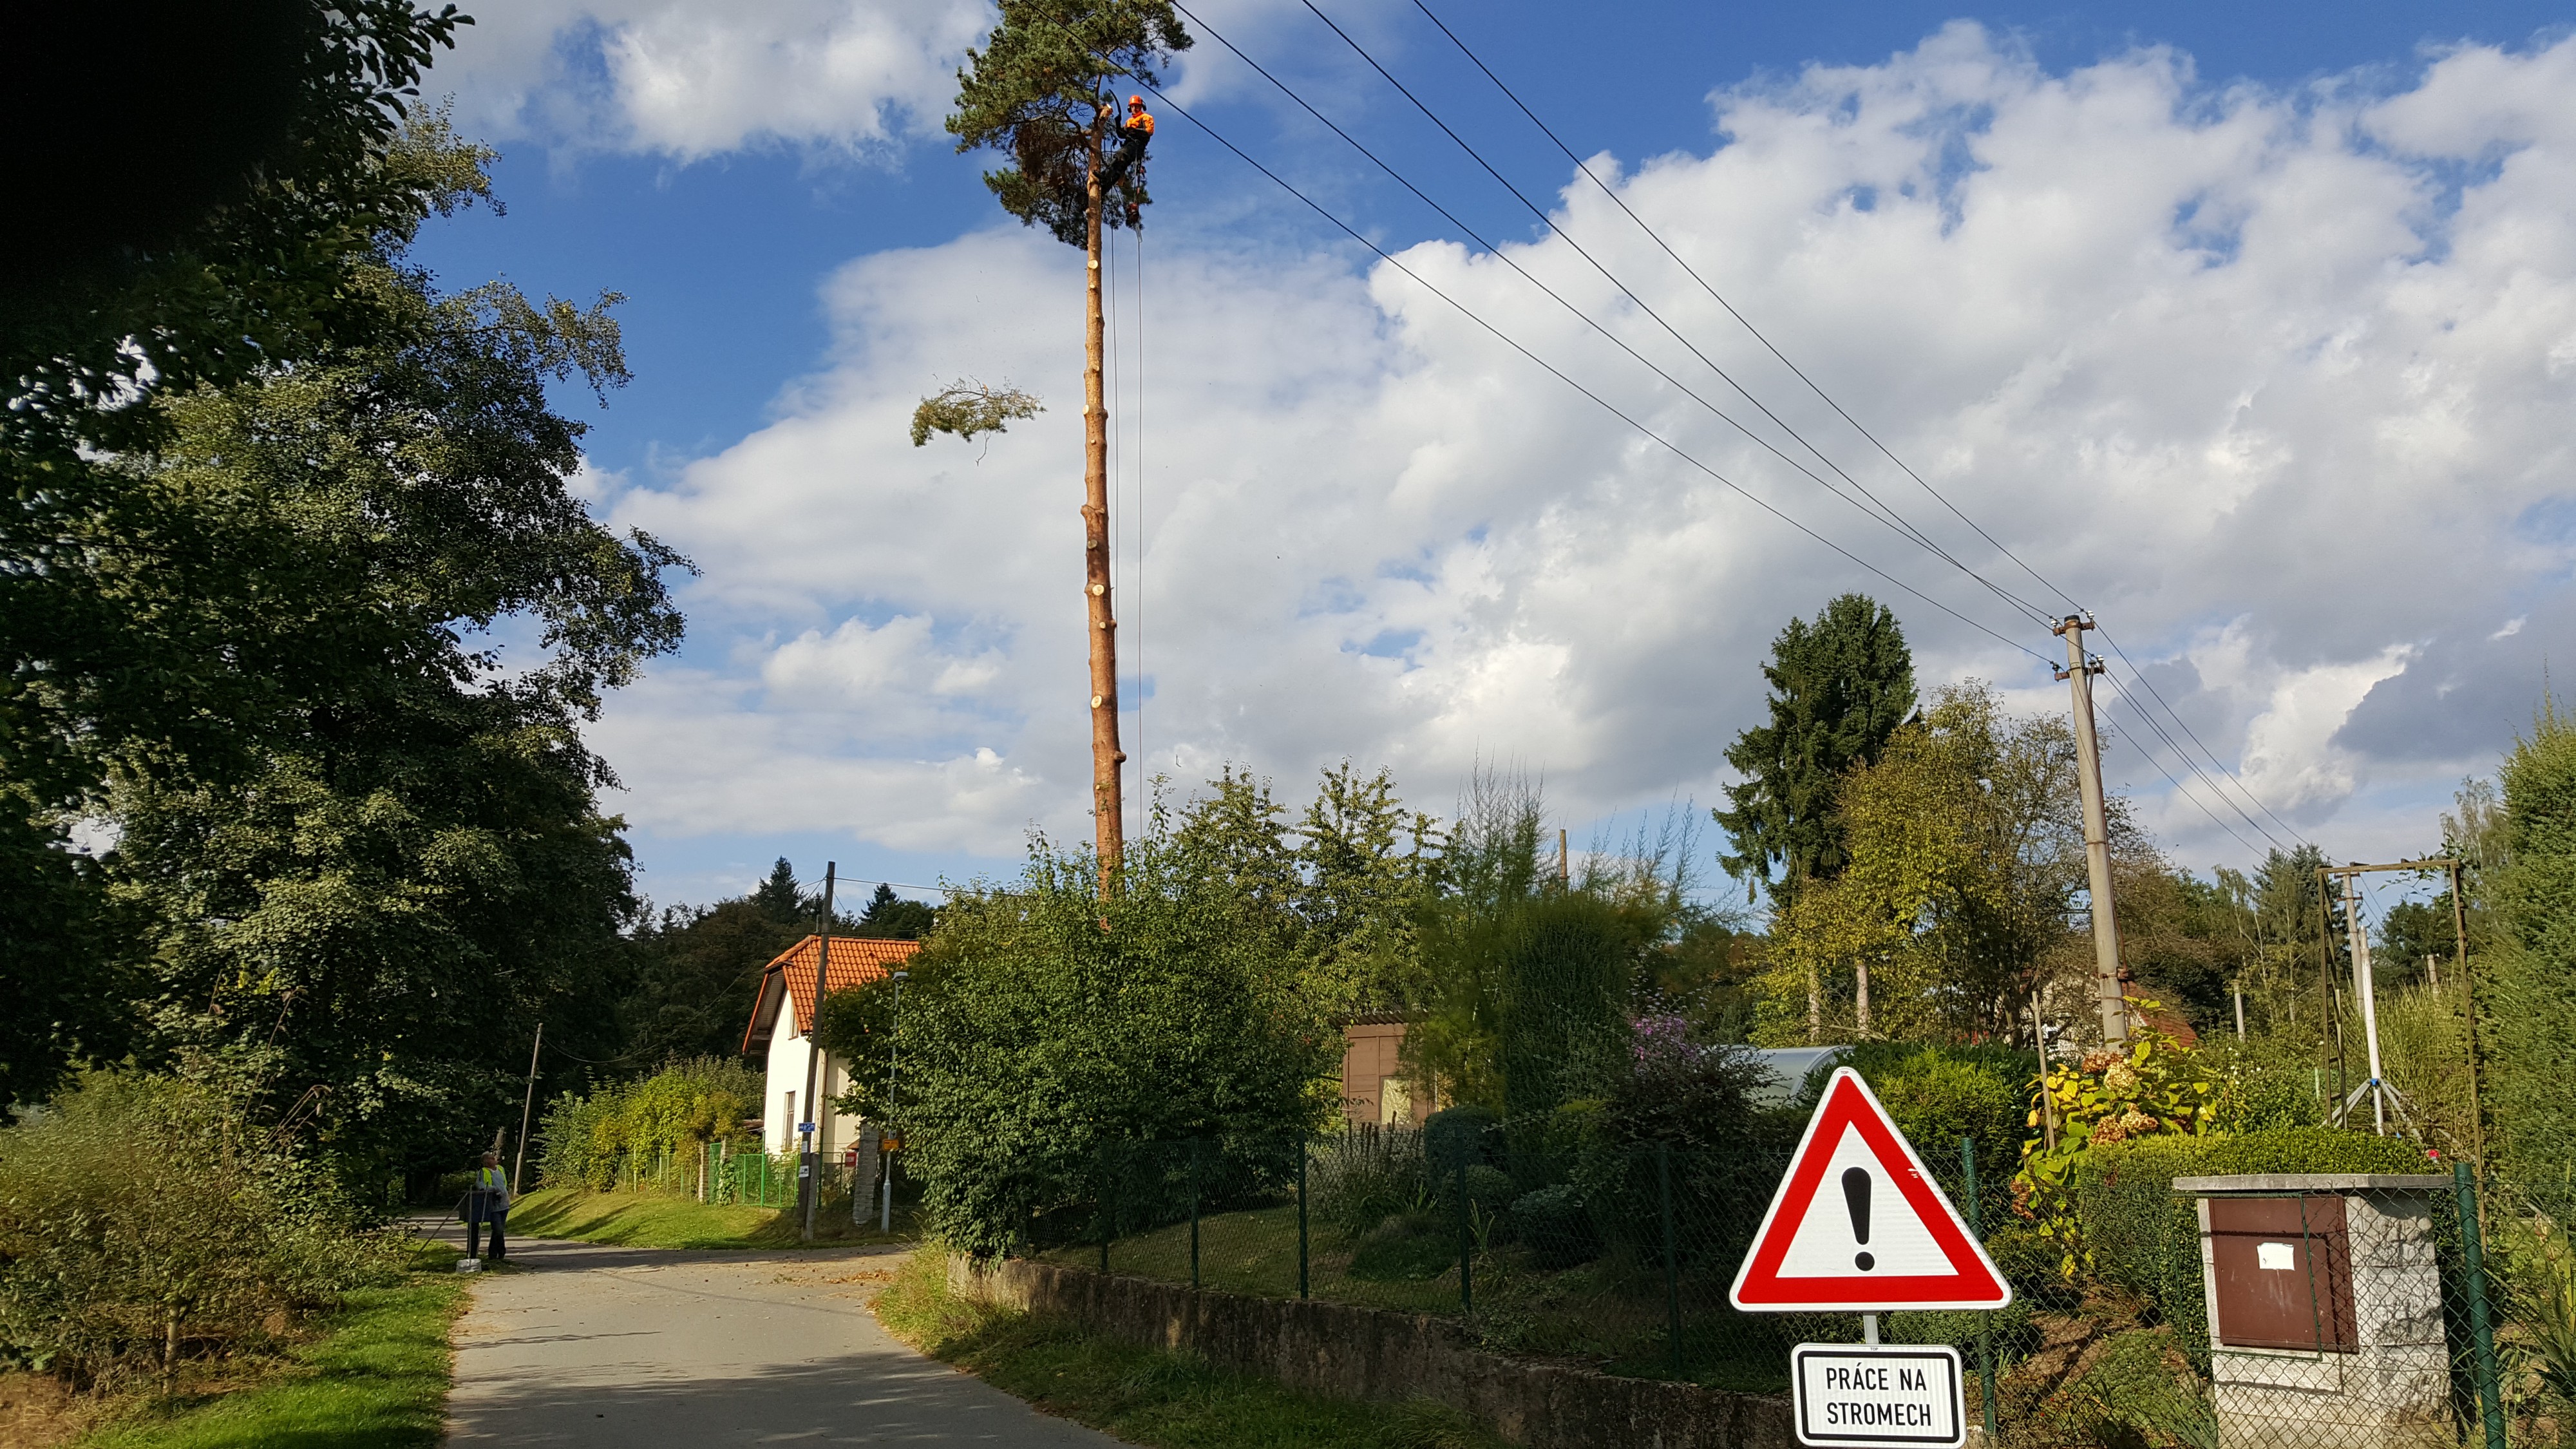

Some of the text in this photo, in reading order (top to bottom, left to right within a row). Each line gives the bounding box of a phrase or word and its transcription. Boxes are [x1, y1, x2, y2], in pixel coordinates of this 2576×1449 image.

[1826, 1362, 1927, 1390] PRÁCE NA
[1826, 1402, 1931, 1426] STROMECH
